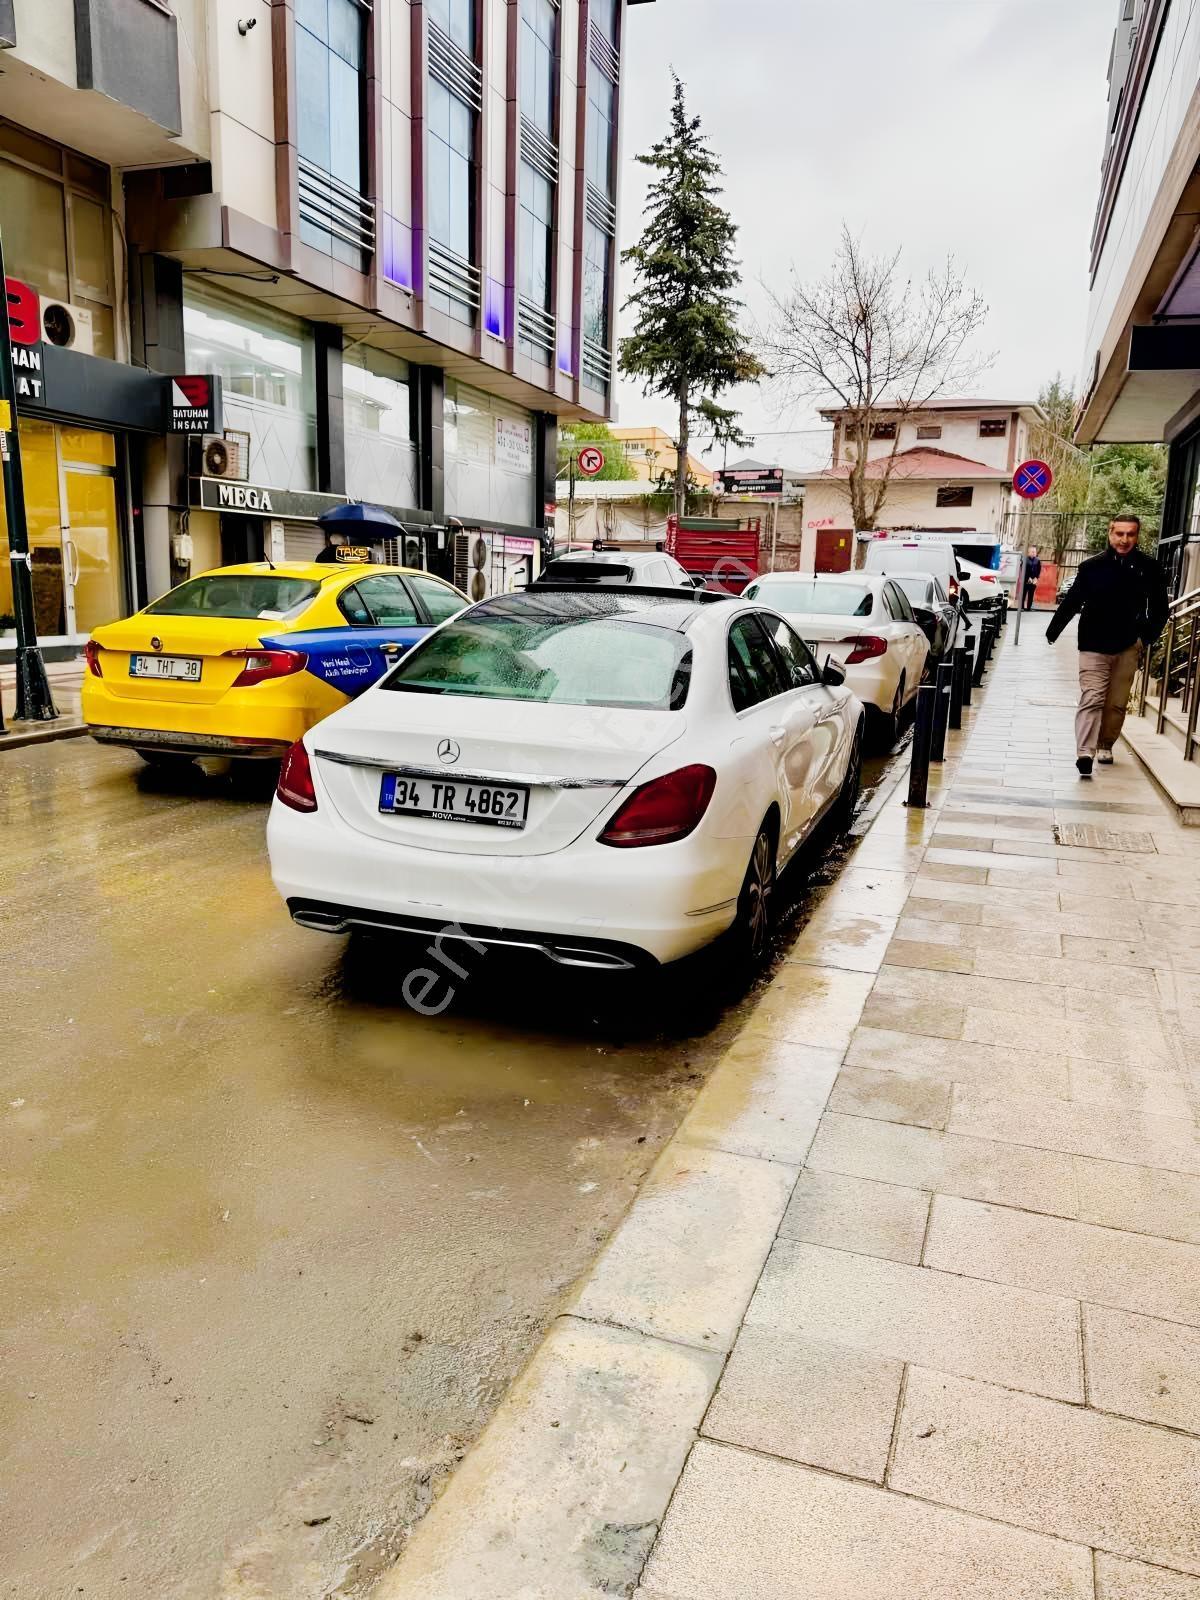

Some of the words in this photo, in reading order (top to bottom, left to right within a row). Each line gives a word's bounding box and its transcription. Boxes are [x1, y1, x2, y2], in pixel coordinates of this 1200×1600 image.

[11, 347, 40, 370] HAN
[19, 377, 41, 397] AT
[172, 408, 209, 419] BATUHAN
[218, 484, 273, 511] MEGA
[137, 658, 149, 672] 34
[157, 659, 176, 674] THT
[184, 662, 198, 676] 38
[395, 780, 420, 807] 34
[431, 784, 456, 811] TR
[464, 787, 519, 818] 4862
[432, 811, 453, 820] NOVA
